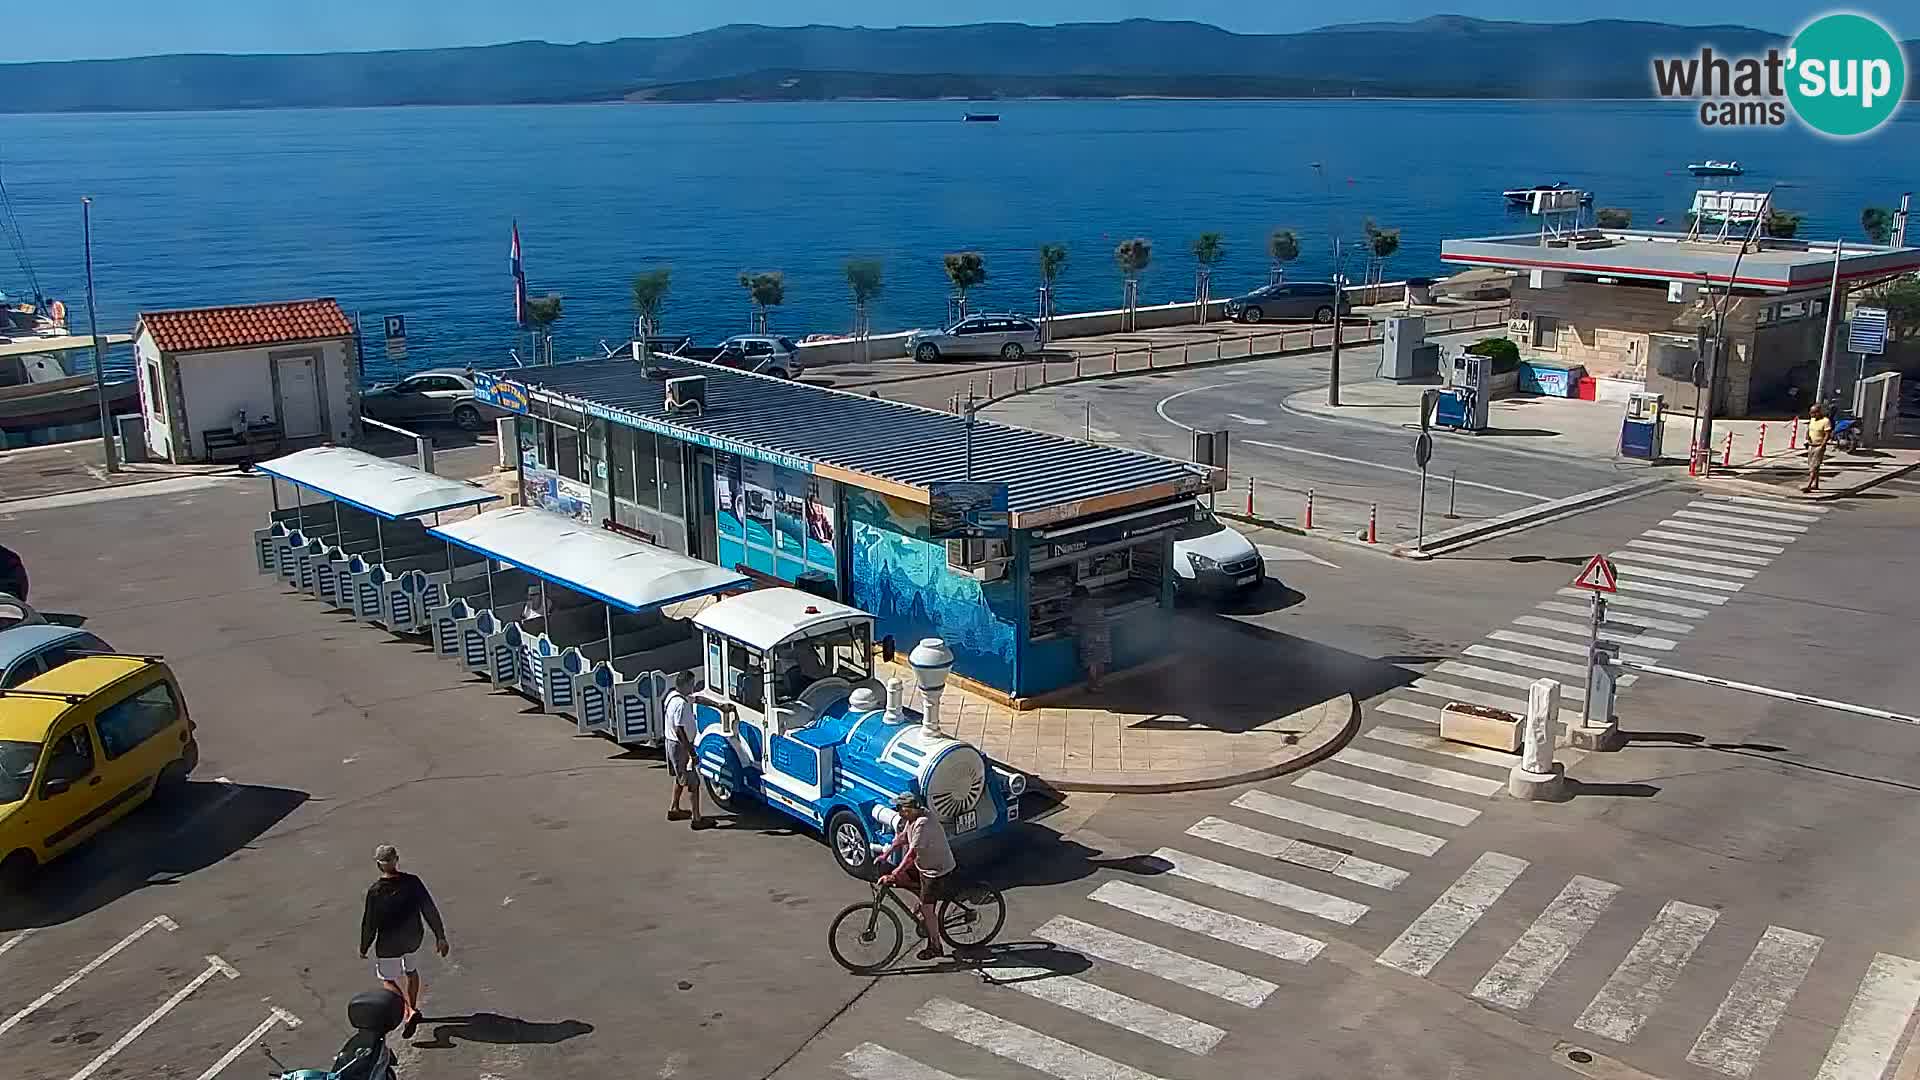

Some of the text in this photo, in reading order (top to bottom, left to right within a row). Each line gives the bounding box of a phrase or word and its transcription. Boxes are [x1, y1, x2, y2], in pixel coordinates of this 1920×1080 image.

[389, 319, 400, 335] P
[671, 427, 700, 445] POSTAJA
[709, 437, 723, 449] BUS
[724, 440, 755, 457] STATION
[757, 449, 781, 464] TICKET
[783, 457, 809, 471] OFFICE
